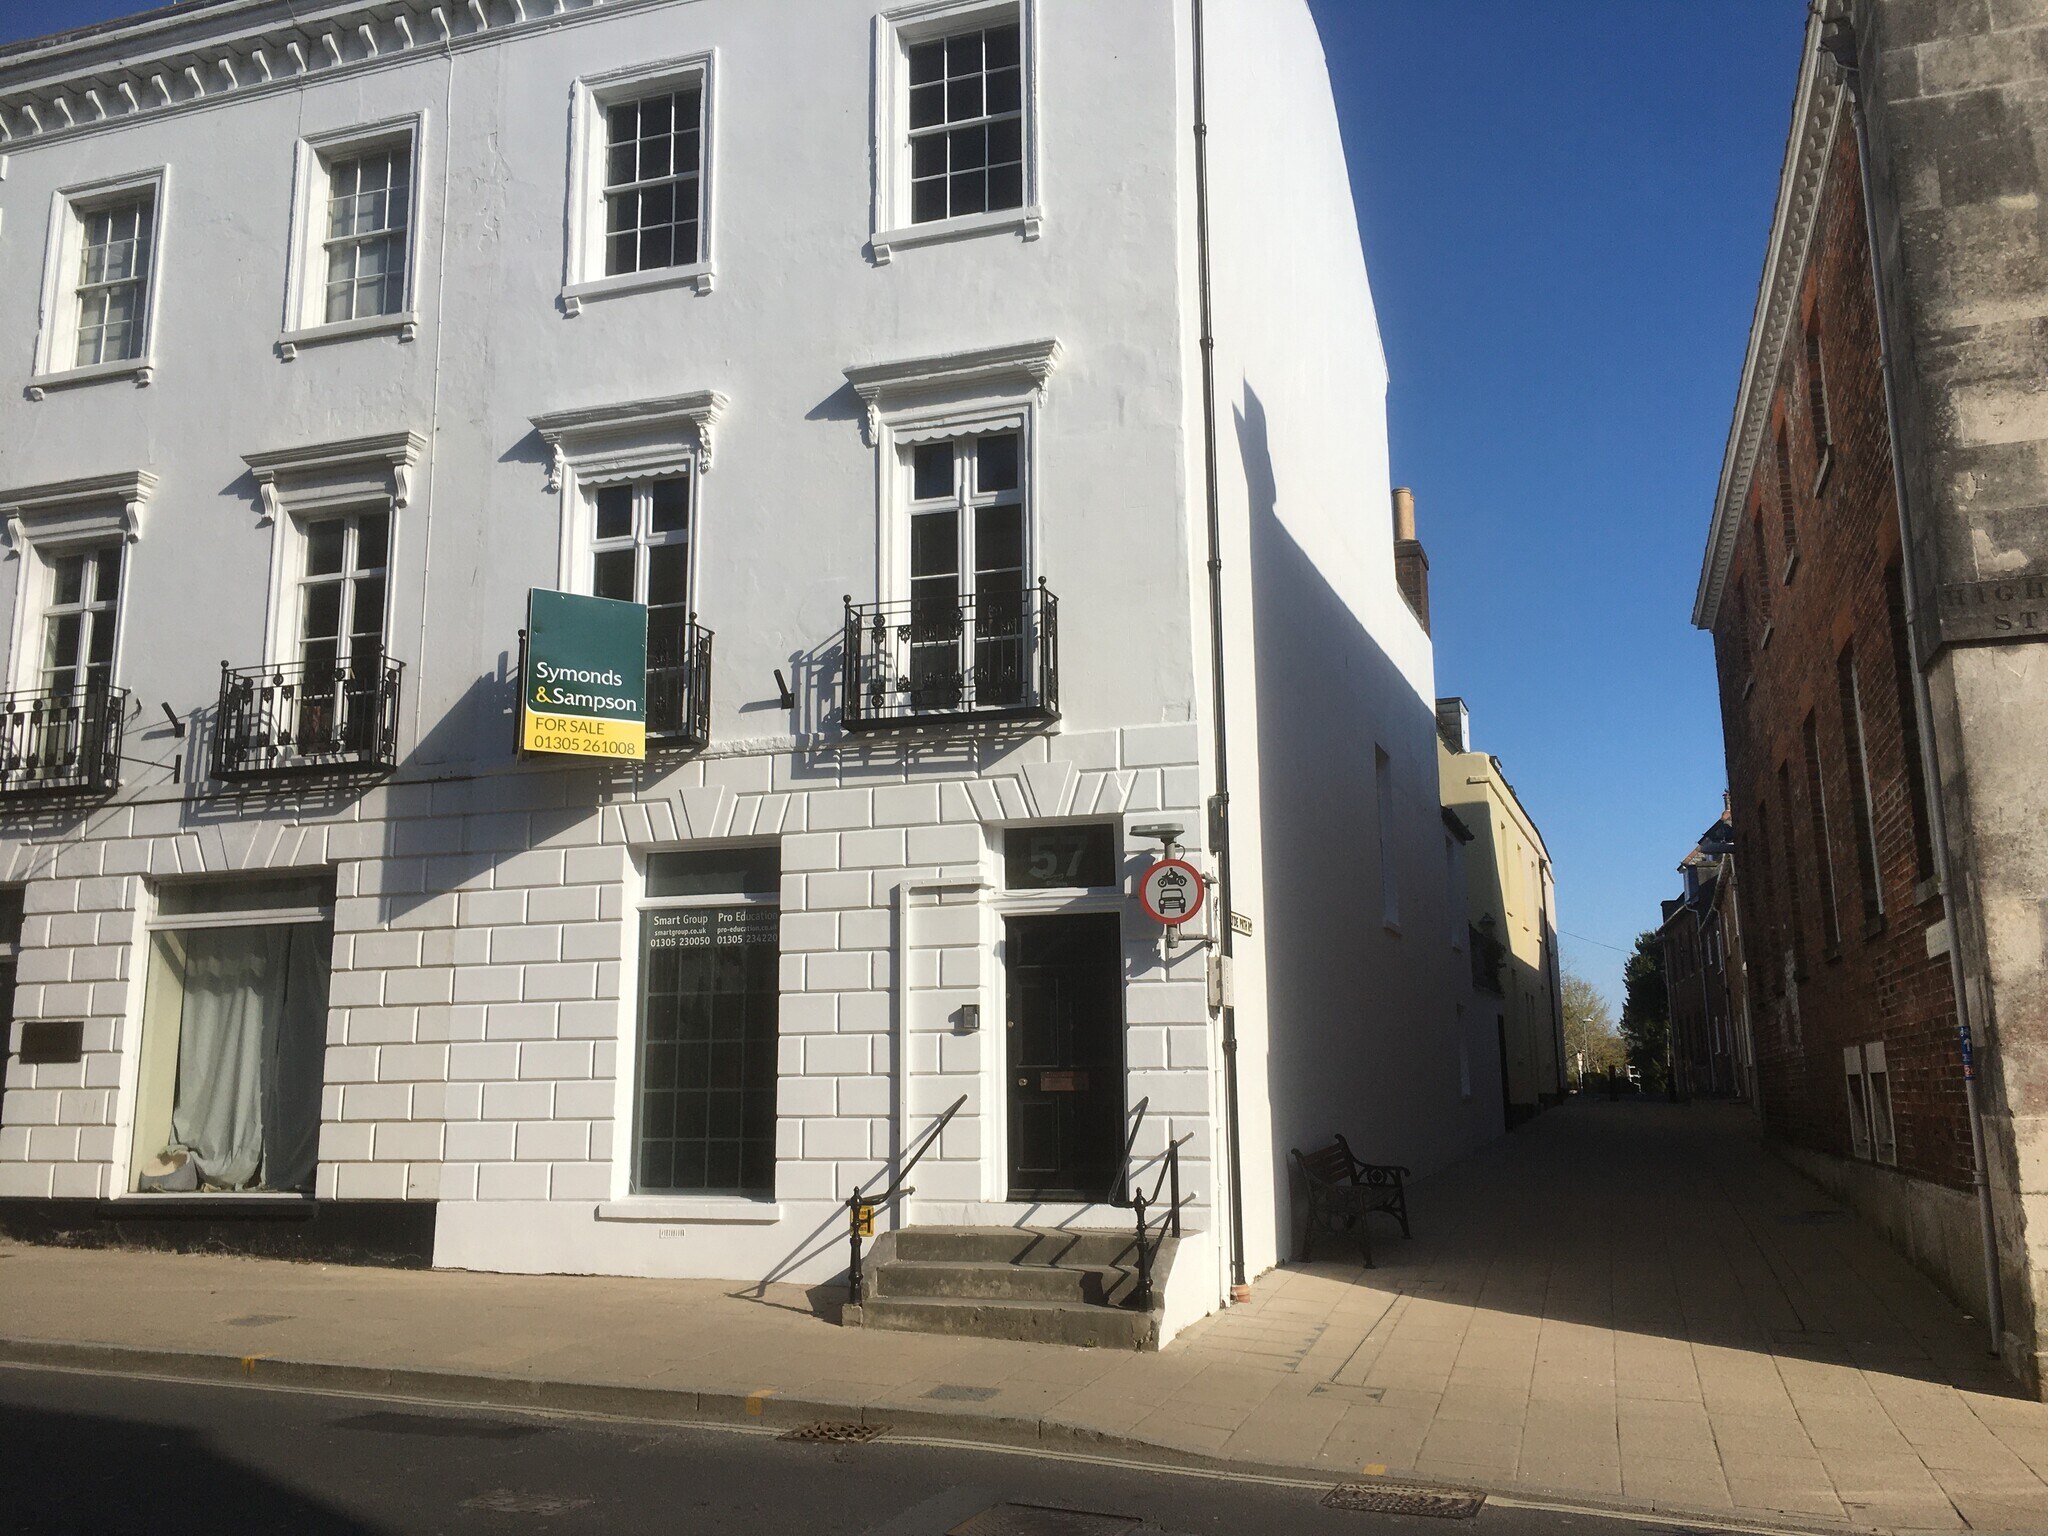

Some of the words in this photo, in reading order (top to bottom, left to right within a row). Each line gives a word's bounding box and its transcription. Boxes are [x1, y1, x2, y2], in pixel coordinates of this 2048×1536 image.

[1944, 579, 2046, 606] HIGH
[1994, 611, 2048, 631] ST
[536, 661, 623, 686] Symonds
[535, 717, 567, 732] FOR
[570, 720, 605, 735] SALE
[534, 735, 580, 751] 01305
[583, 739, 635, 755] 261008
[1028, 835, 1088, 878] 57
[653, 915, 681, 926] Smart
[683, 914, 709, 926] Group
[718, 912, 733, 923] Pro
[735, 911, 778, 922] Education
[654, 927, 707, 937] smartgroup.co.uk
[717, 935, 743, 945] 01305
[650, 938, 677, 947] 01305
[679, 936, 711, 946] 230050
